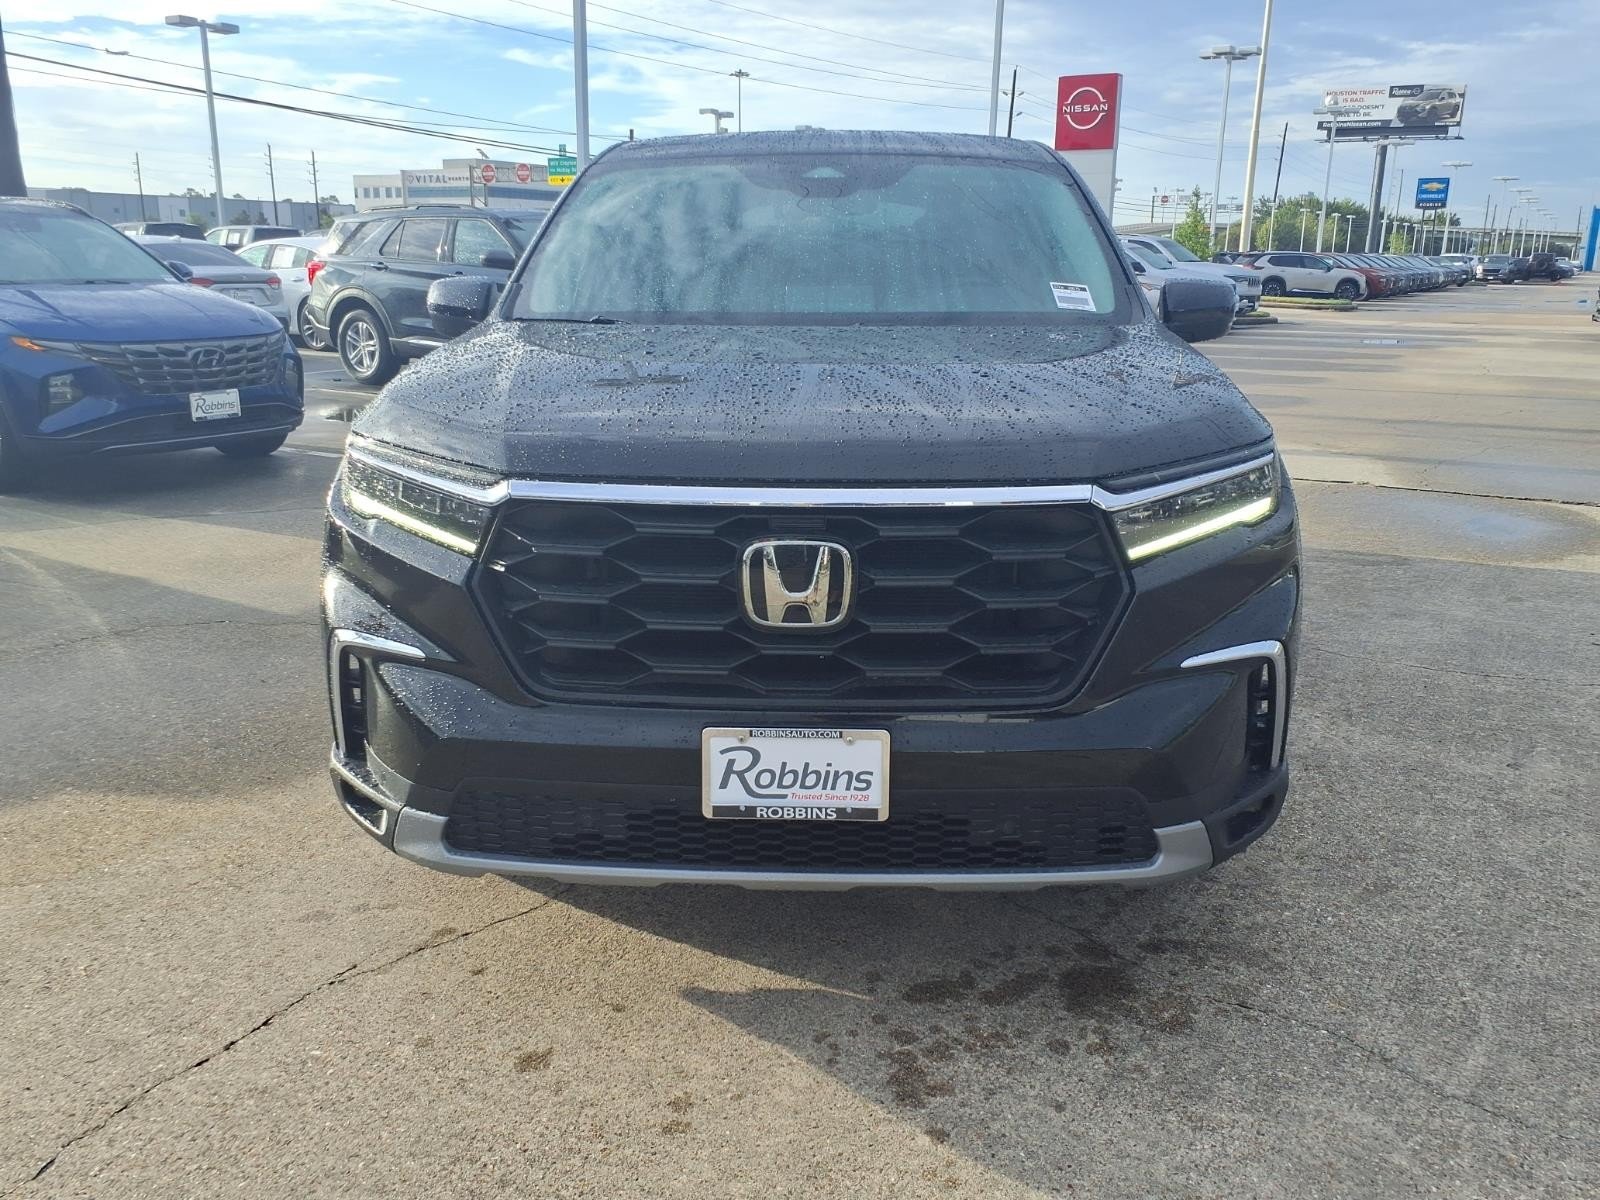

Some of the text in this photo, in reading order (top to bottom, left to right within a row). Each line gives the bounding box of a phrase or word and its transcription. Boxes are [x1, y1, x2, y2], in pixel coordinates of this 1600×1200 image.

[1062, 103, 1108, 113] NISSAN
[415, 174, 448, 184] VITAL
[194, 397, 236, 414] Robbins
[752, 729, 840, 739] ROBBINSAUTO.COM
[718, 746, 874, 800] Robbins
[789, 792, 870, 802] Trusted Since 1928
[756, 806, 837, 819] ROBBINS
